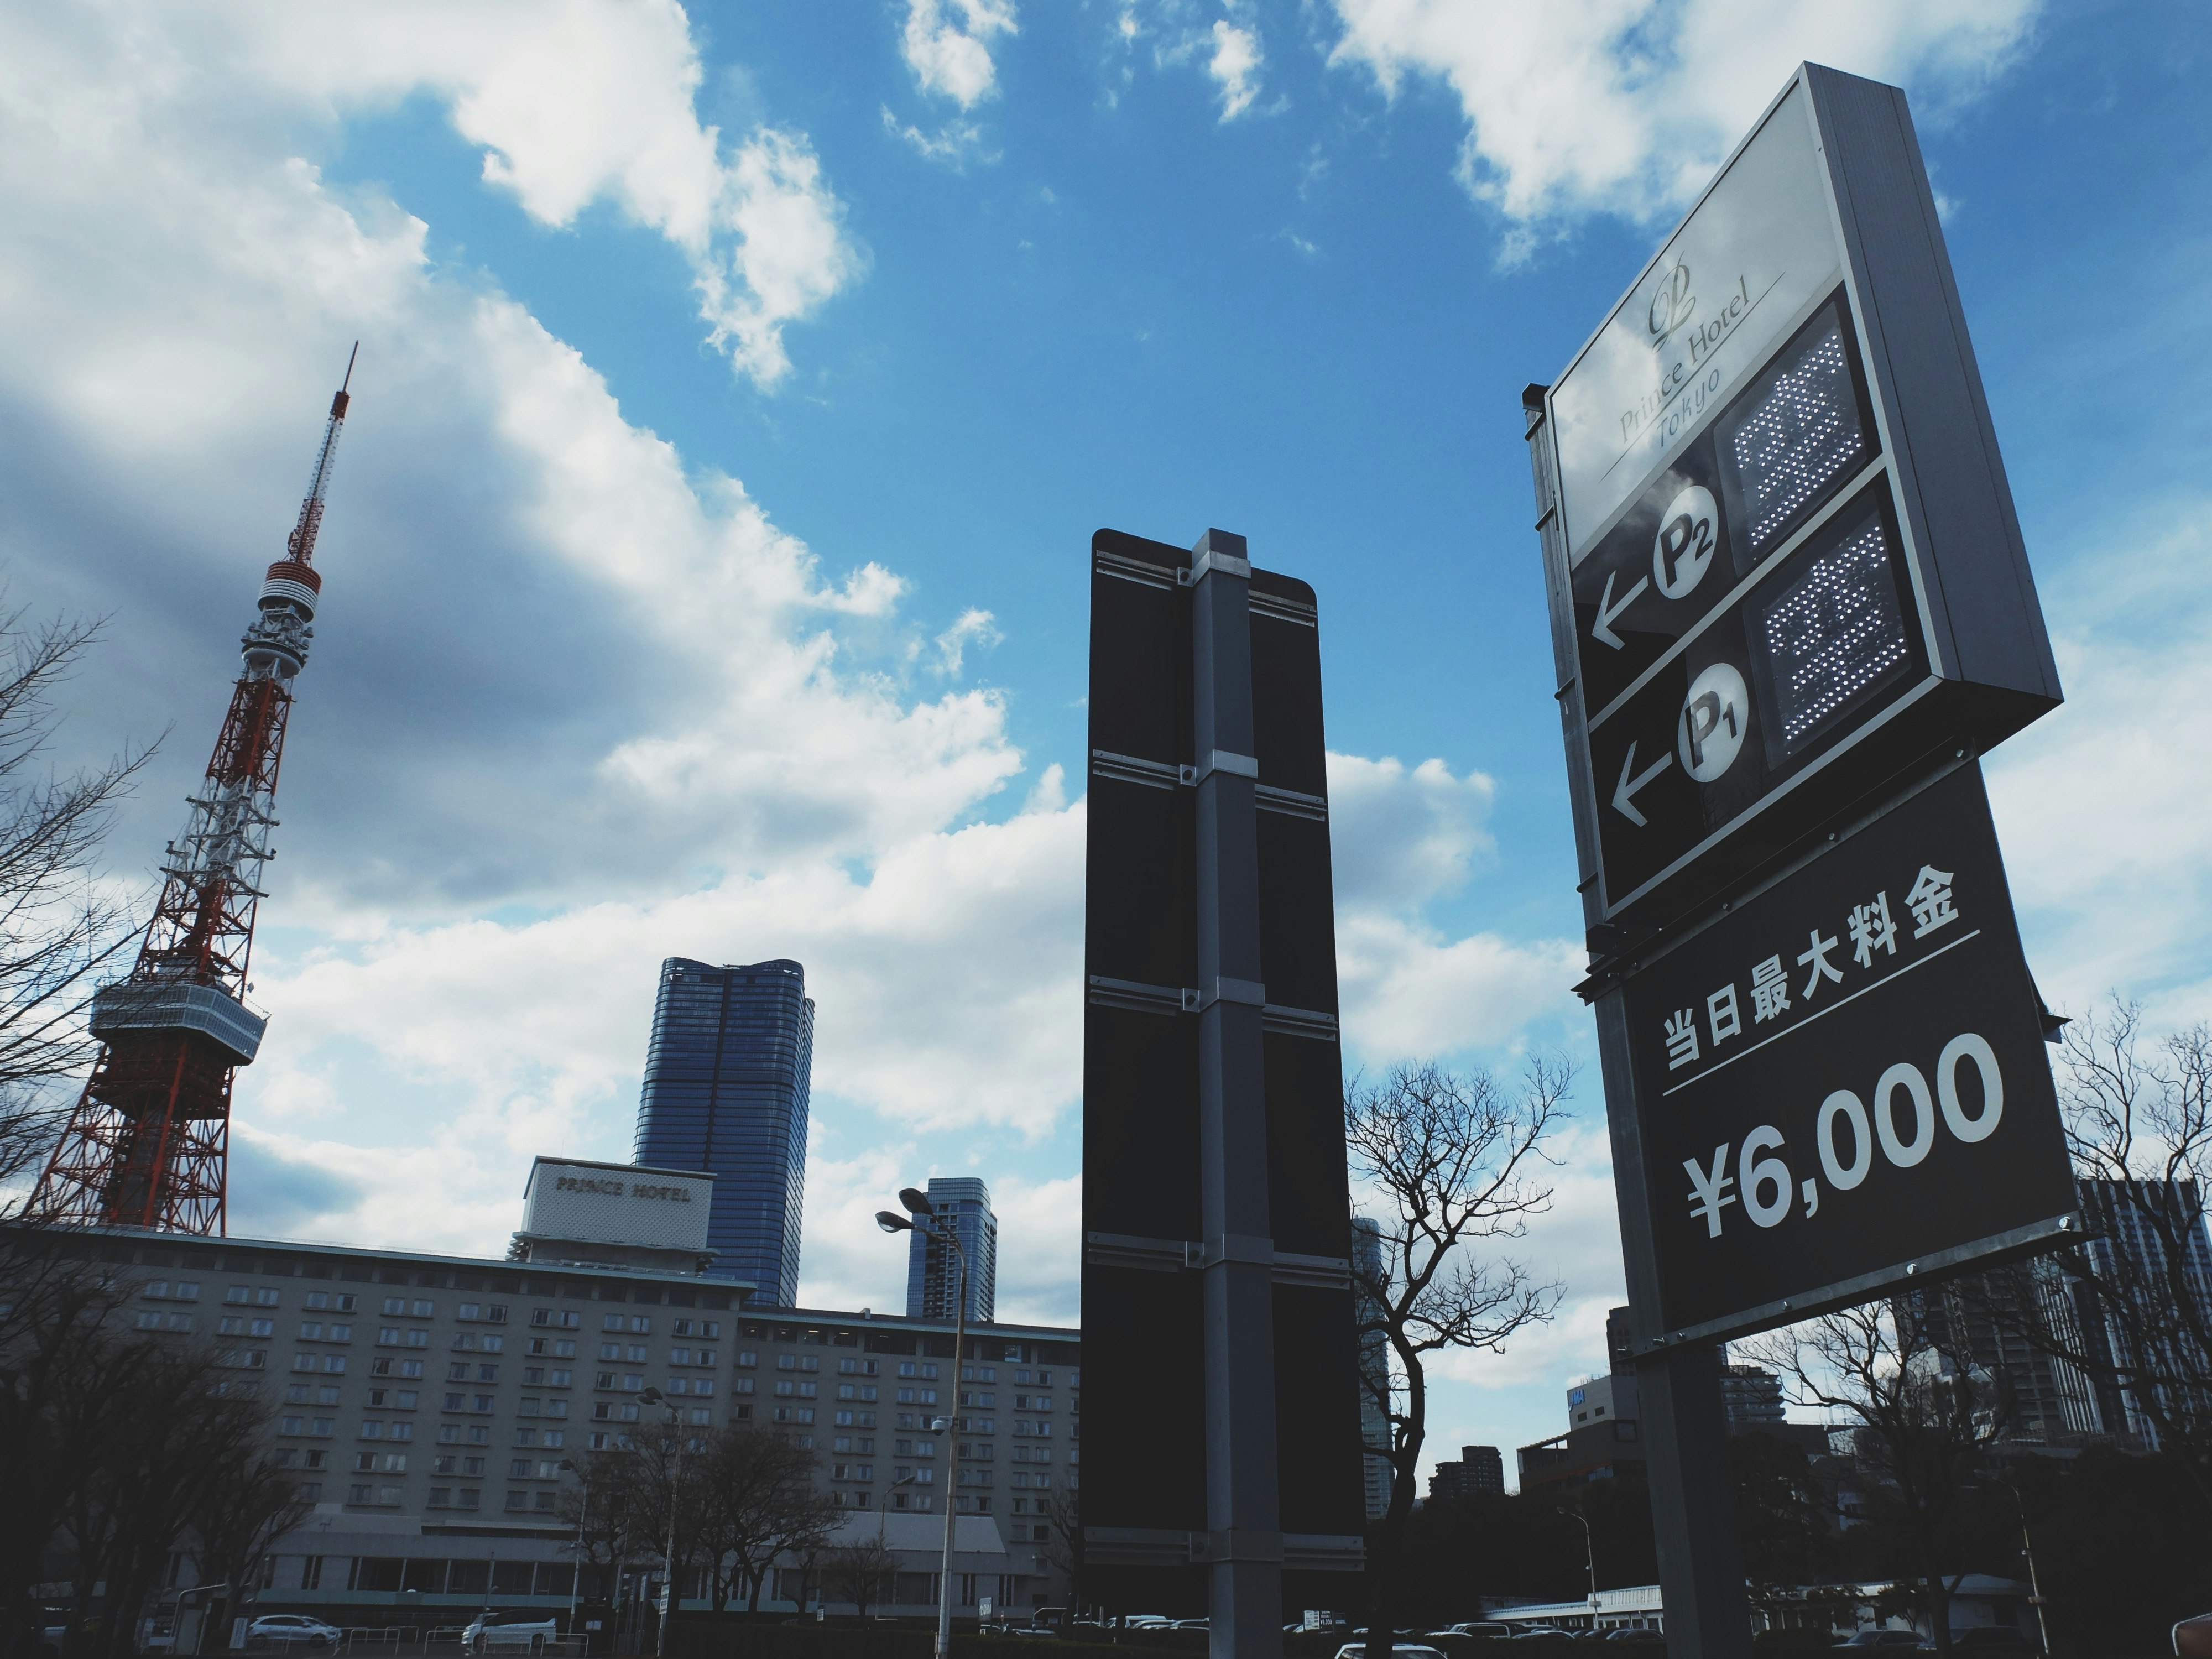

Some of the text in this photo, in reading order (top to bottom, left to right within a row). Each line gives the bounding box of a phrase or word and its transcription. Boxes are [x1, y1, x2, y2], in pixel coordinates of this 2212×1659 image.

[1620, 274, 1749, 445] Prince Hotel
[1657, 369, 1719, 448] Tokyo
[1734, 334, 1862, 546] 空
[1660, 513, 1713, 589] P2
[1767, 526, 1906, 740] 空
[1684, 690, 1738, 770] P1
[1663, 864, 1959, 1071] 当日最大料金
[556, 1176, 691, 1202] PRINCE HOTEL
[1682, 1032, 2004, 1239] ¥6,000
